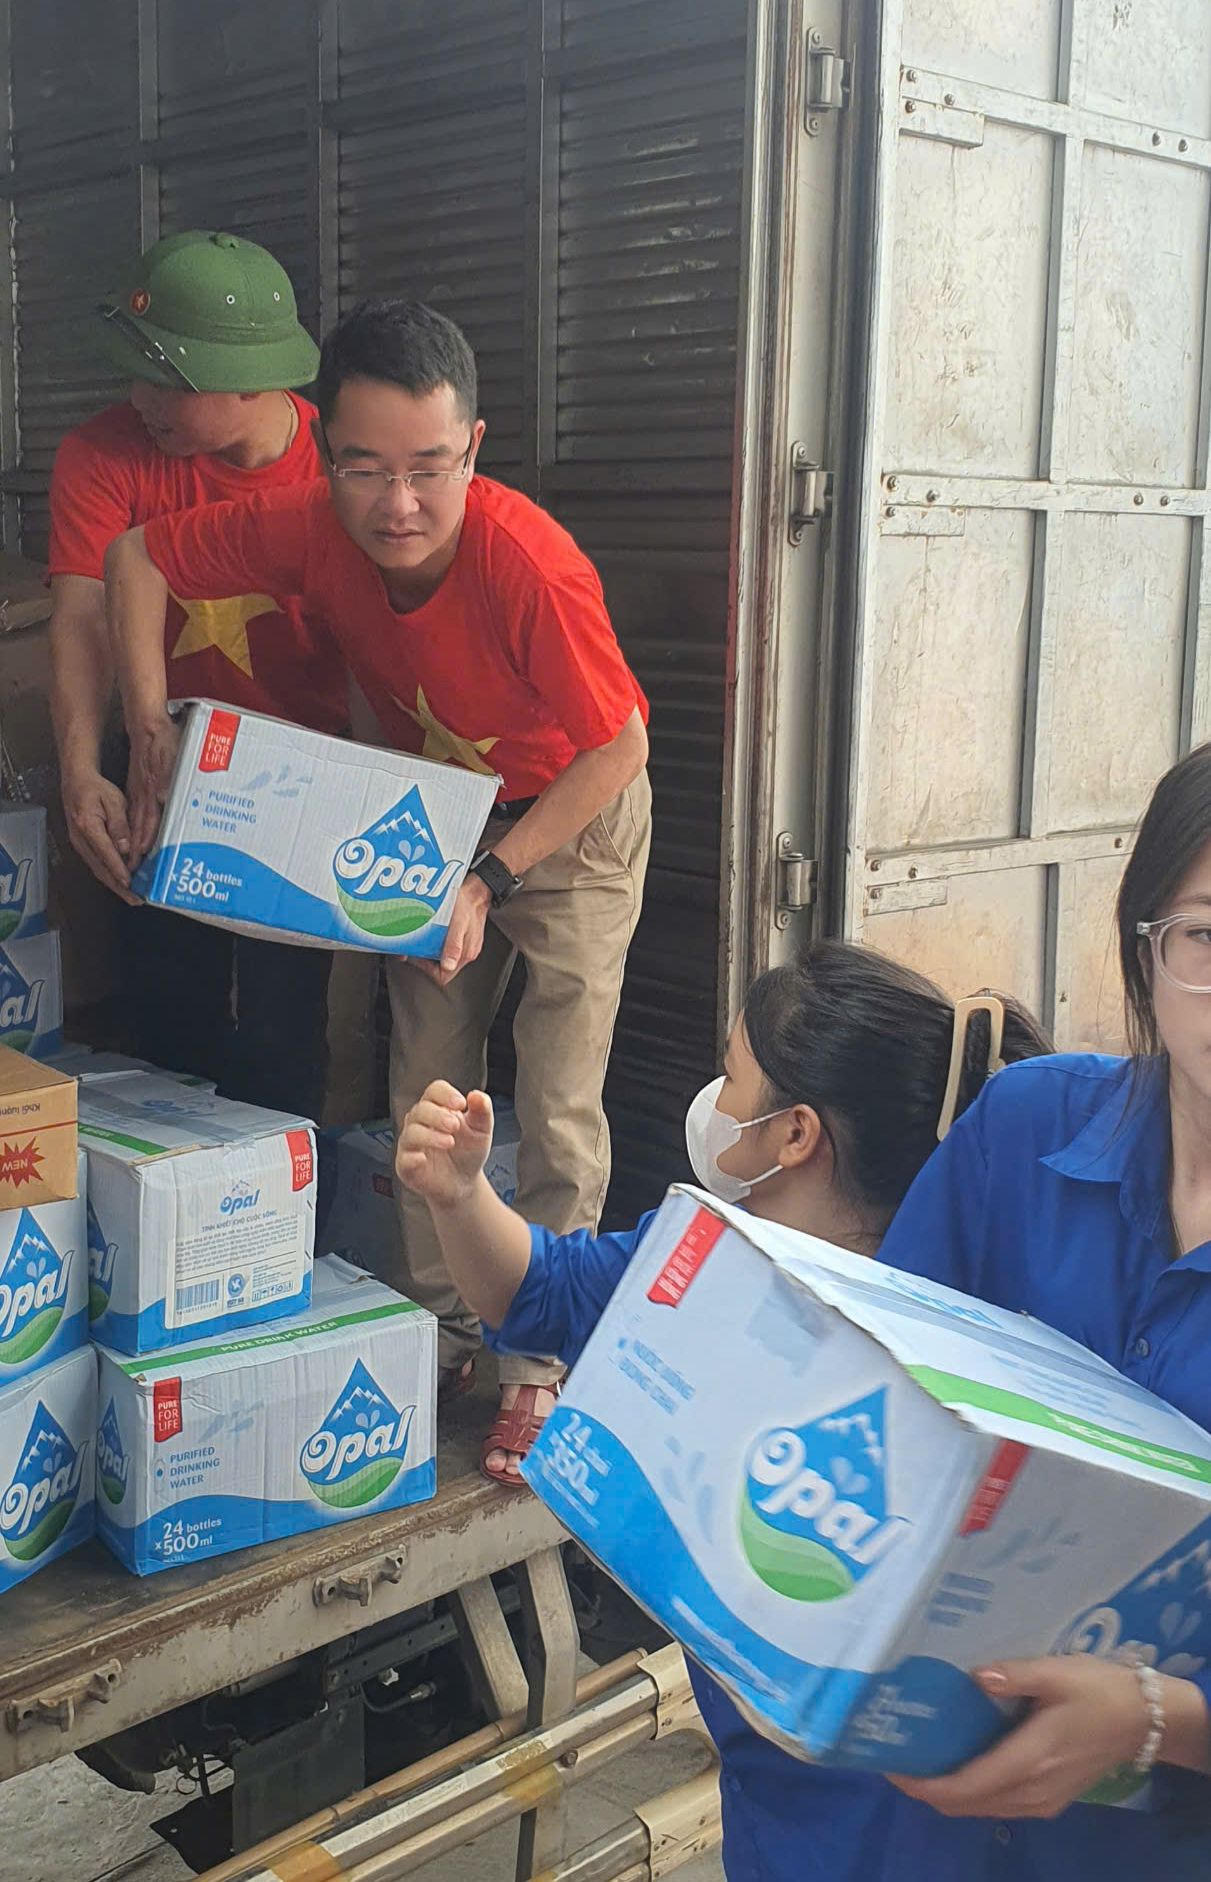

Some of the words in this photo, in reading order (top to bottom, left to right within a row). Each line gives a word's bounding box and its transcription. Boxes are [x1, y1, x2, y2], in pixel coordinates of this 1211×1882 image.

[208, 742, 230, 756] FOR
[205, 752, 225, 766] LIFE
[208, 790, 255, 809] PURIFIED
[205, 804, 257, 824] DRINKING
[202, 817, 237, 834] WATER
[181, 857, 205, 878] 24
[206, 868, 243, 887] bottles
[334, 837, 465, 898] Opal
[1, 1158, 29, 1173] NEW
[295, 1160, 311, 1172] FOR
[295, 1170, 312, 1182] LIFE
[220, 1188, 260, 1215] Opal
[295, 1321, 338, 1336] WATER
[158, 1408, 179, 1421] FOR
[159, 1419, 178, 1432] LIFE
[301, 1404, 416, 1481] Opal
[170, 1446, 215, 1463] PURIFIED
[170, 1458, 220, 1477] DRINKING
[0, 1440, 89, 1535] Opal
[170, 1474, 204, 1489] WATER
[746, 1426, 916, 1566] Opal
[163, 1519, 183, 1539] 24
[186, 1518, 222, 1533] bottles
